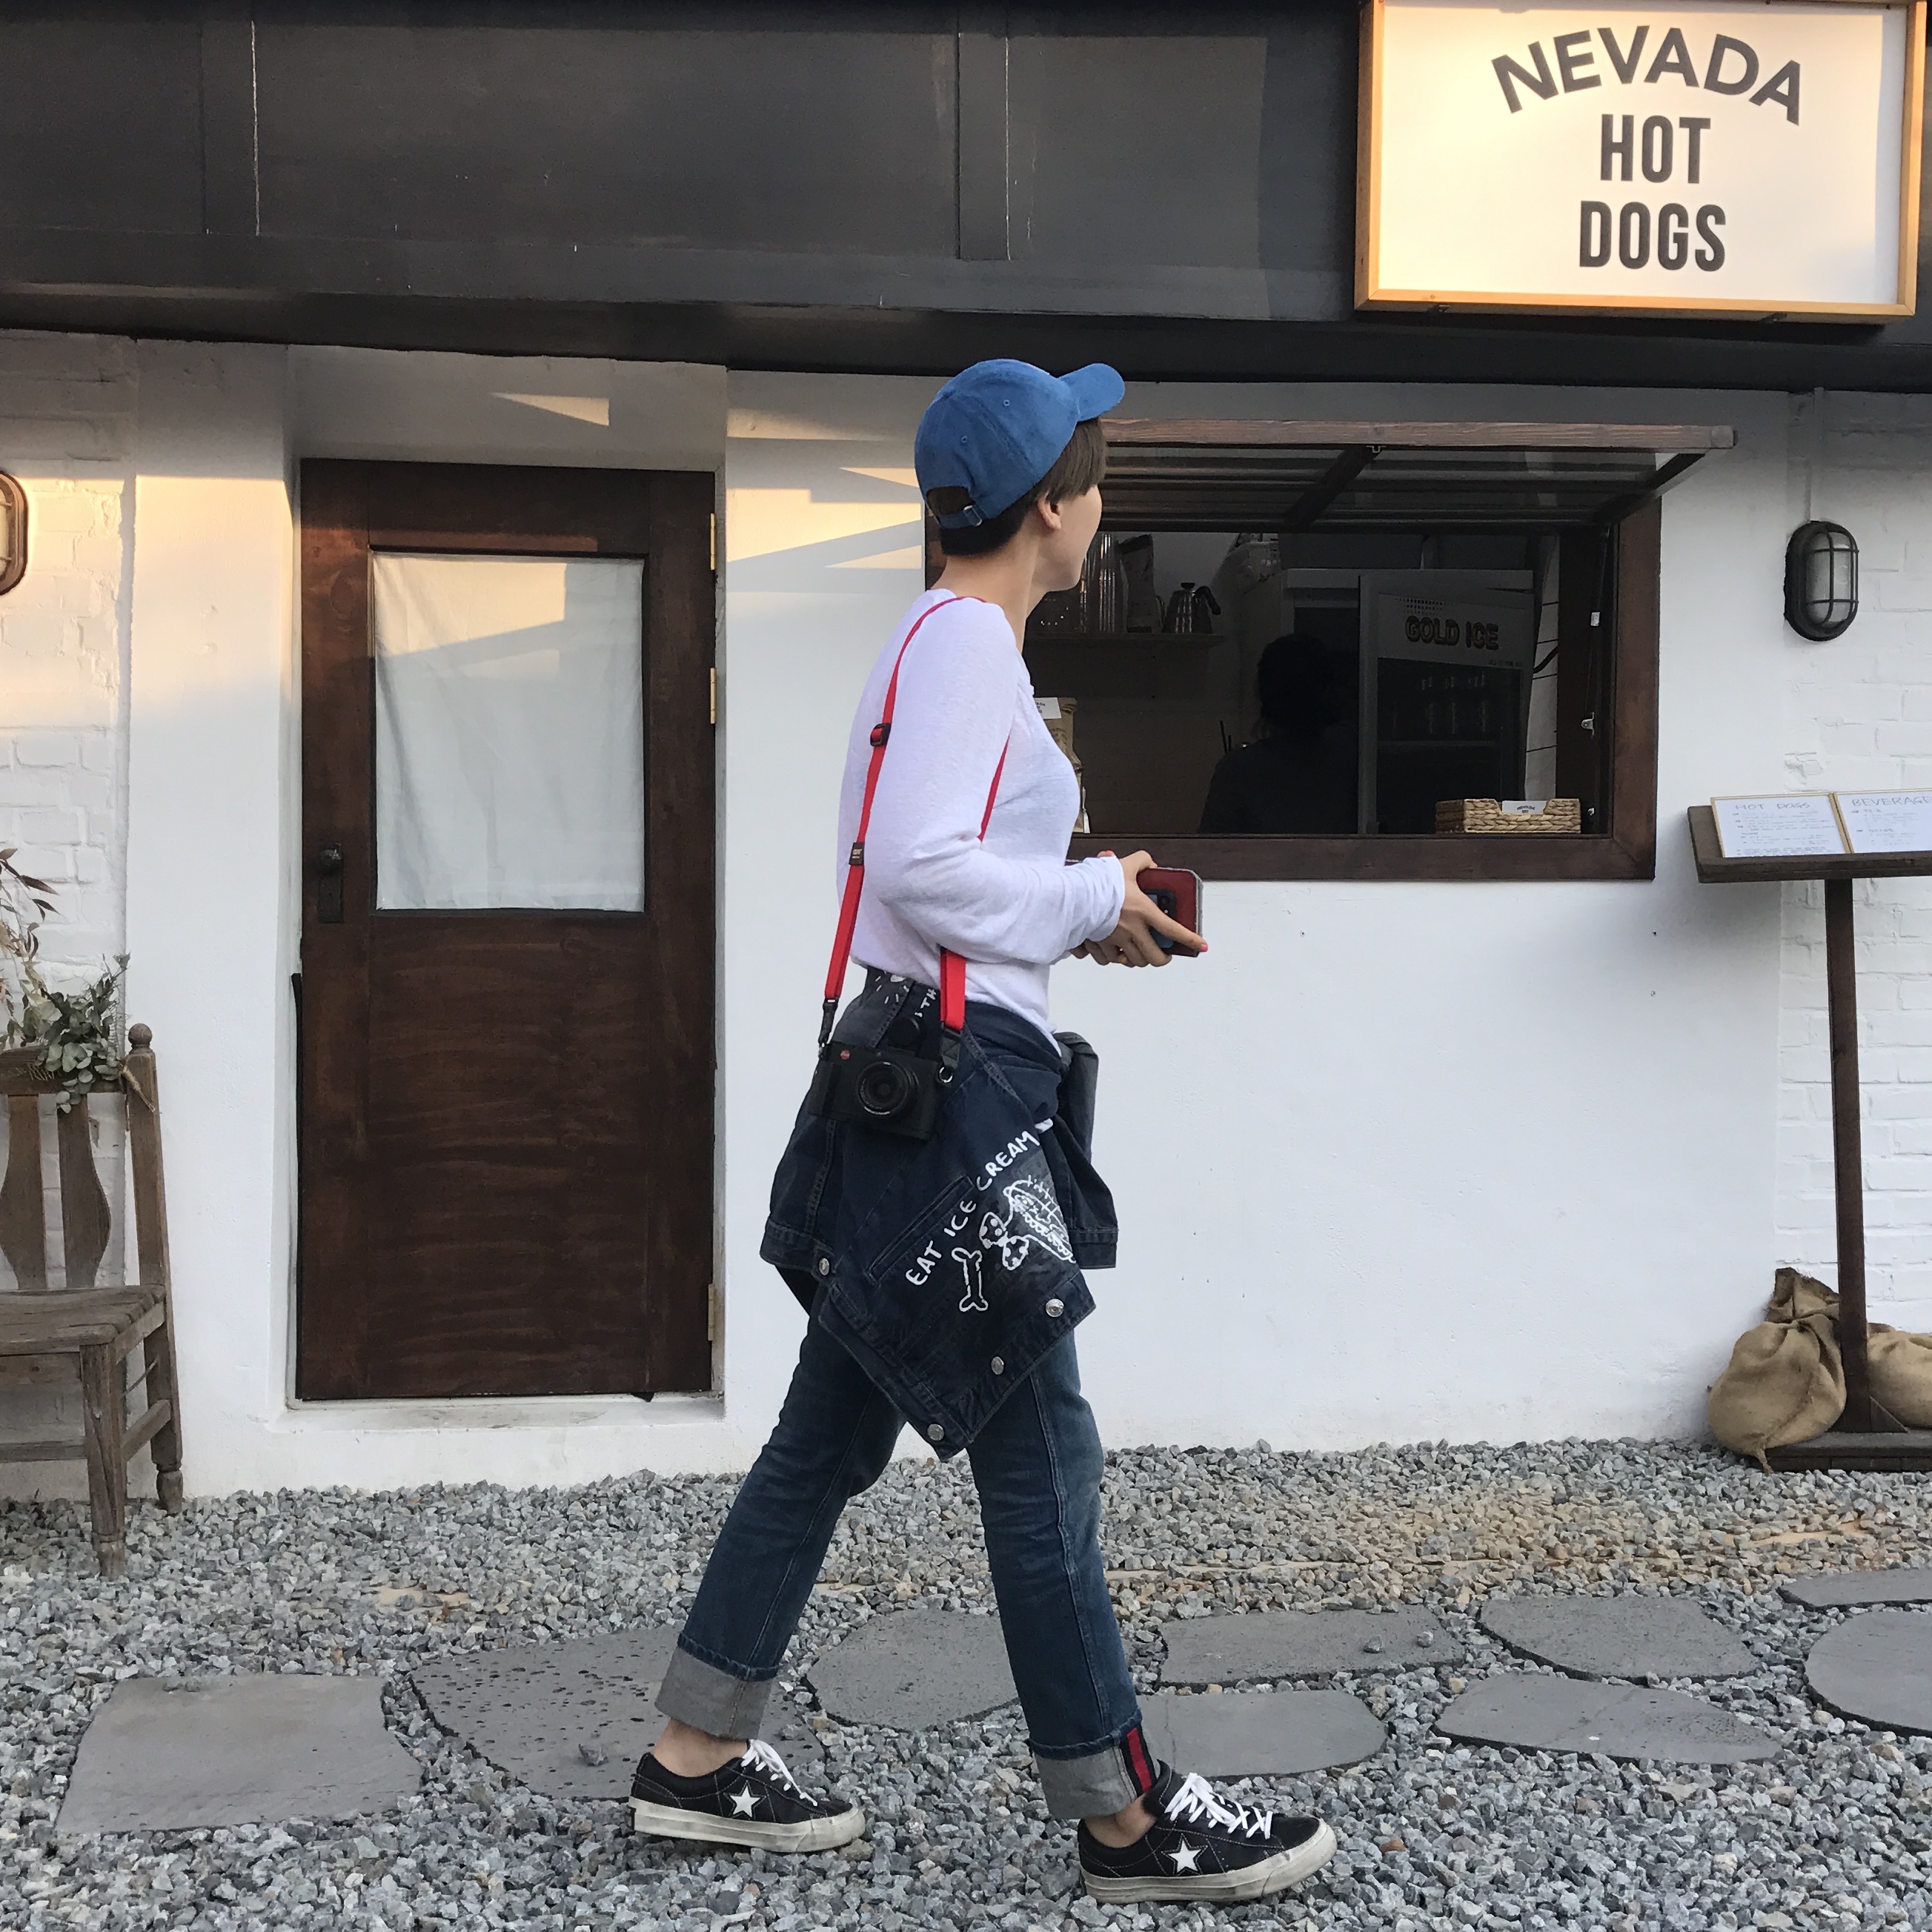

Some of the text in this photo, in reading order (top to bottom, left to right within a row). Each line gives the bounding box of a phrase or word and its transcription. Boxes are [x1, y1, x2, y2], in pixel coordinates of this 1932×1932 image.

[1491, 25, 1801, 126] NEVADA
[1600, 113, 1711, 185] HOT
[1579, 200, 1727, 272] DOGS
[1405, 615, 1499, 651] GOLD ICE
[1776, 801, 1810, 809] DOGS
[1851, 796, 1932, 807] BEVERAGE
[905, 1130, 1040, 1286] EAT ICE CREAM
